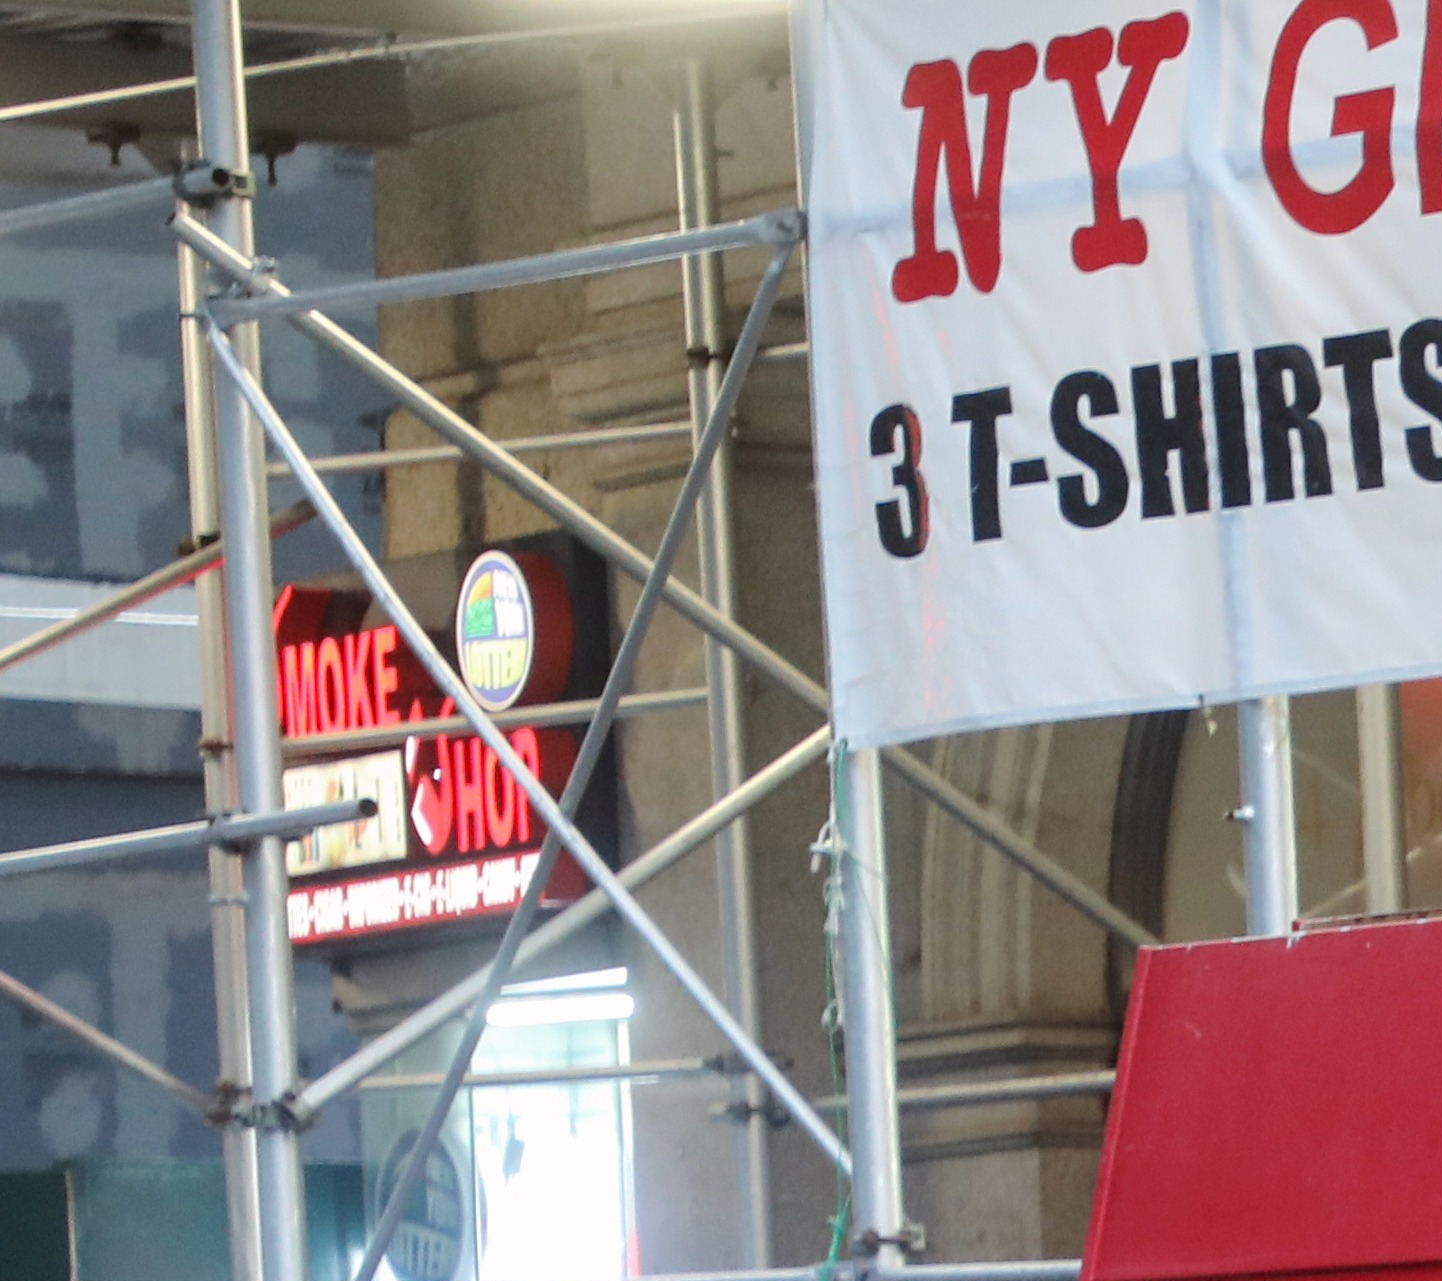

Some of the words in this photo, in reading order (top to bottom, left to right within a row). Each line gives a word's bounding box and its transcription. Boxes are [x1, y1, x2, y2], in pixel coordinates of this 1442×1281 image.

[891, 11, 1190, 304] NY
[868, 402, 931, 560] 3
[276, 625, 400, 739] MOKE
